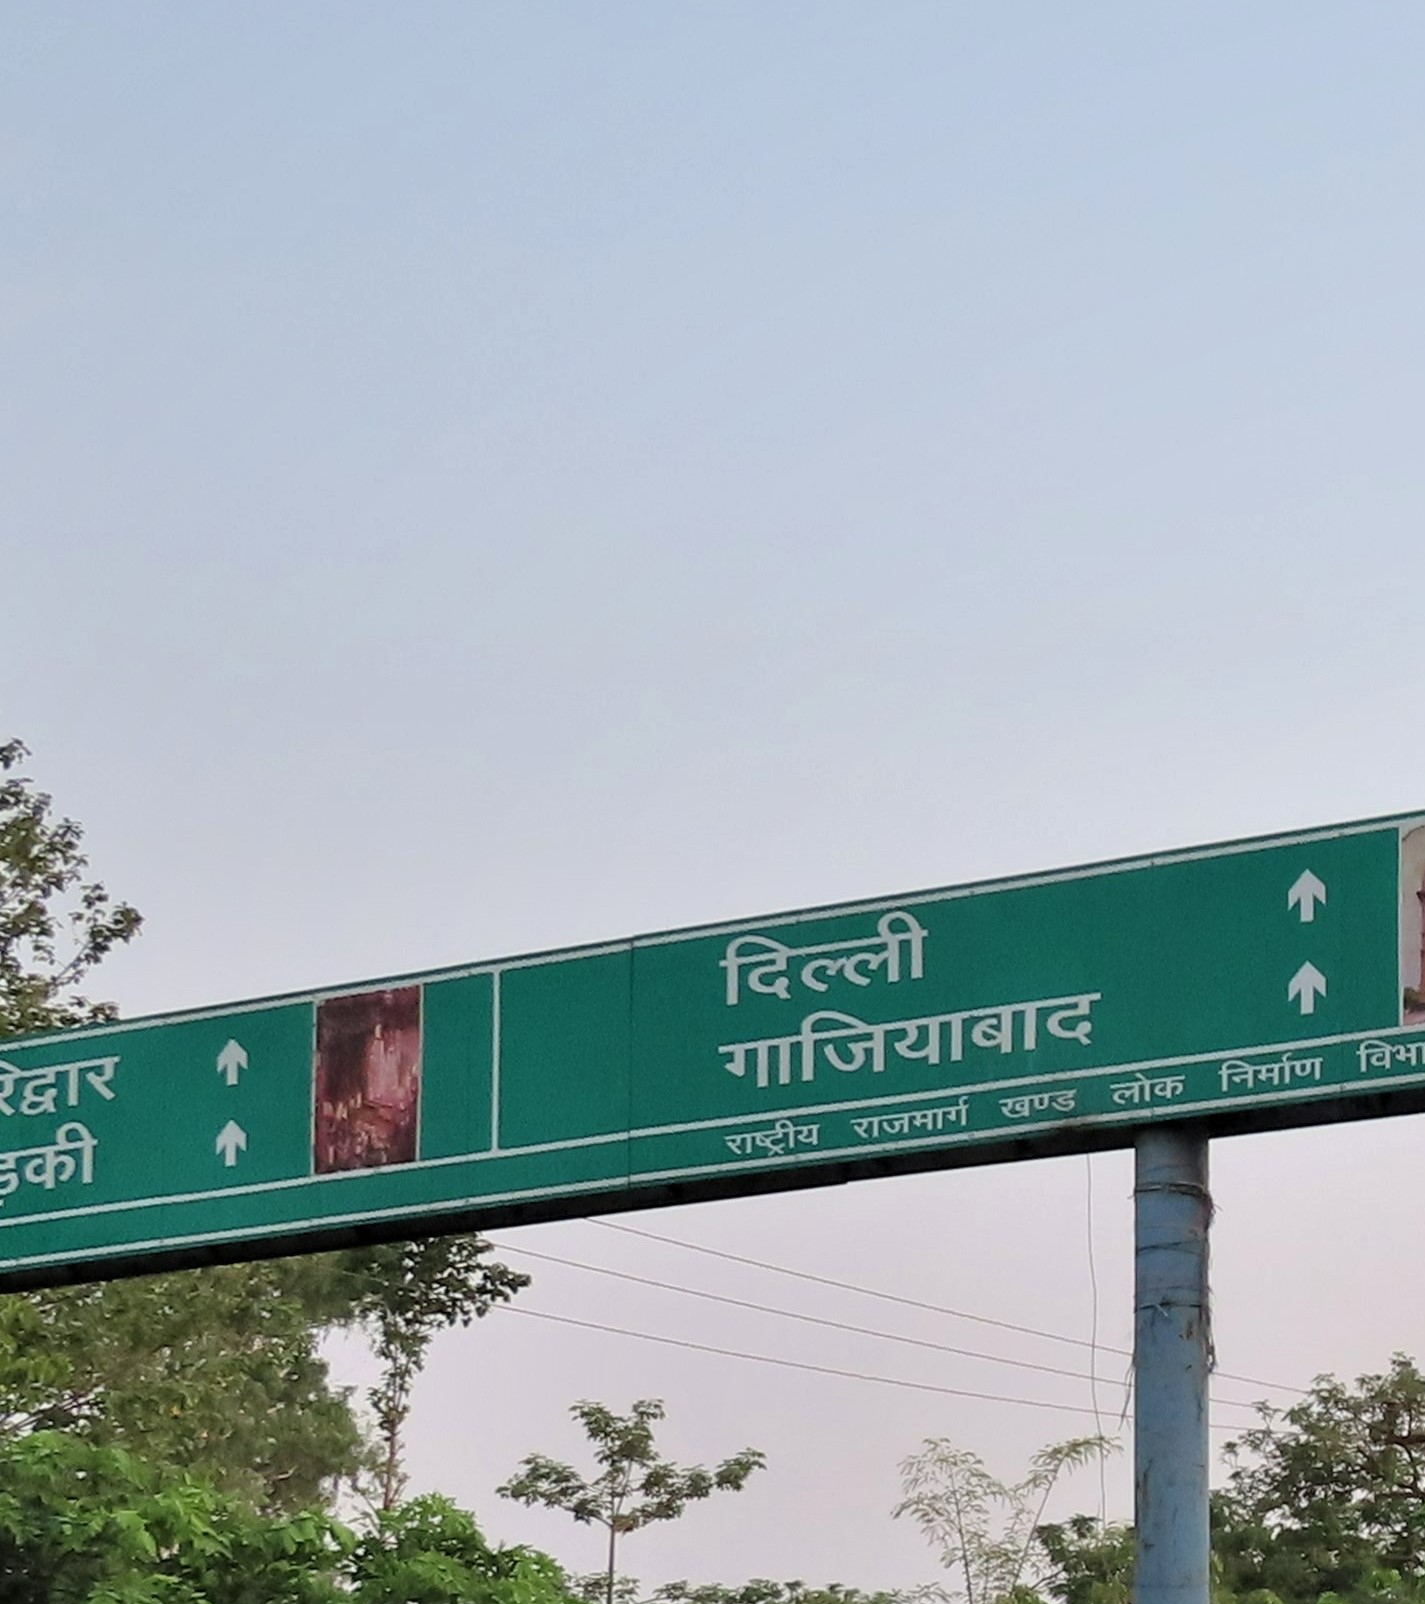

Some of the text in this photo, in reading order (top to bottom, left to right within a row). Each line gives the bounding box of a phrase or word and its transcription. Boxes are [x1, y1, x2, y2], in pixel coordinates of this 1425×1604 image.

[719, 911, 928, 1005] दिल्ली
[718, 992, 1102, 1088] गाजियाबाद
[725, 1119, 820, 1156] राष्ट्रीय
[851, 1096, 969, 1139] राजमार्ग
[999, 1089, 1077, 1119] खण्ड
[1109, 1072, 1185, 1104] लोक
[1218, 1053, 1323, 1094] निर्माण
